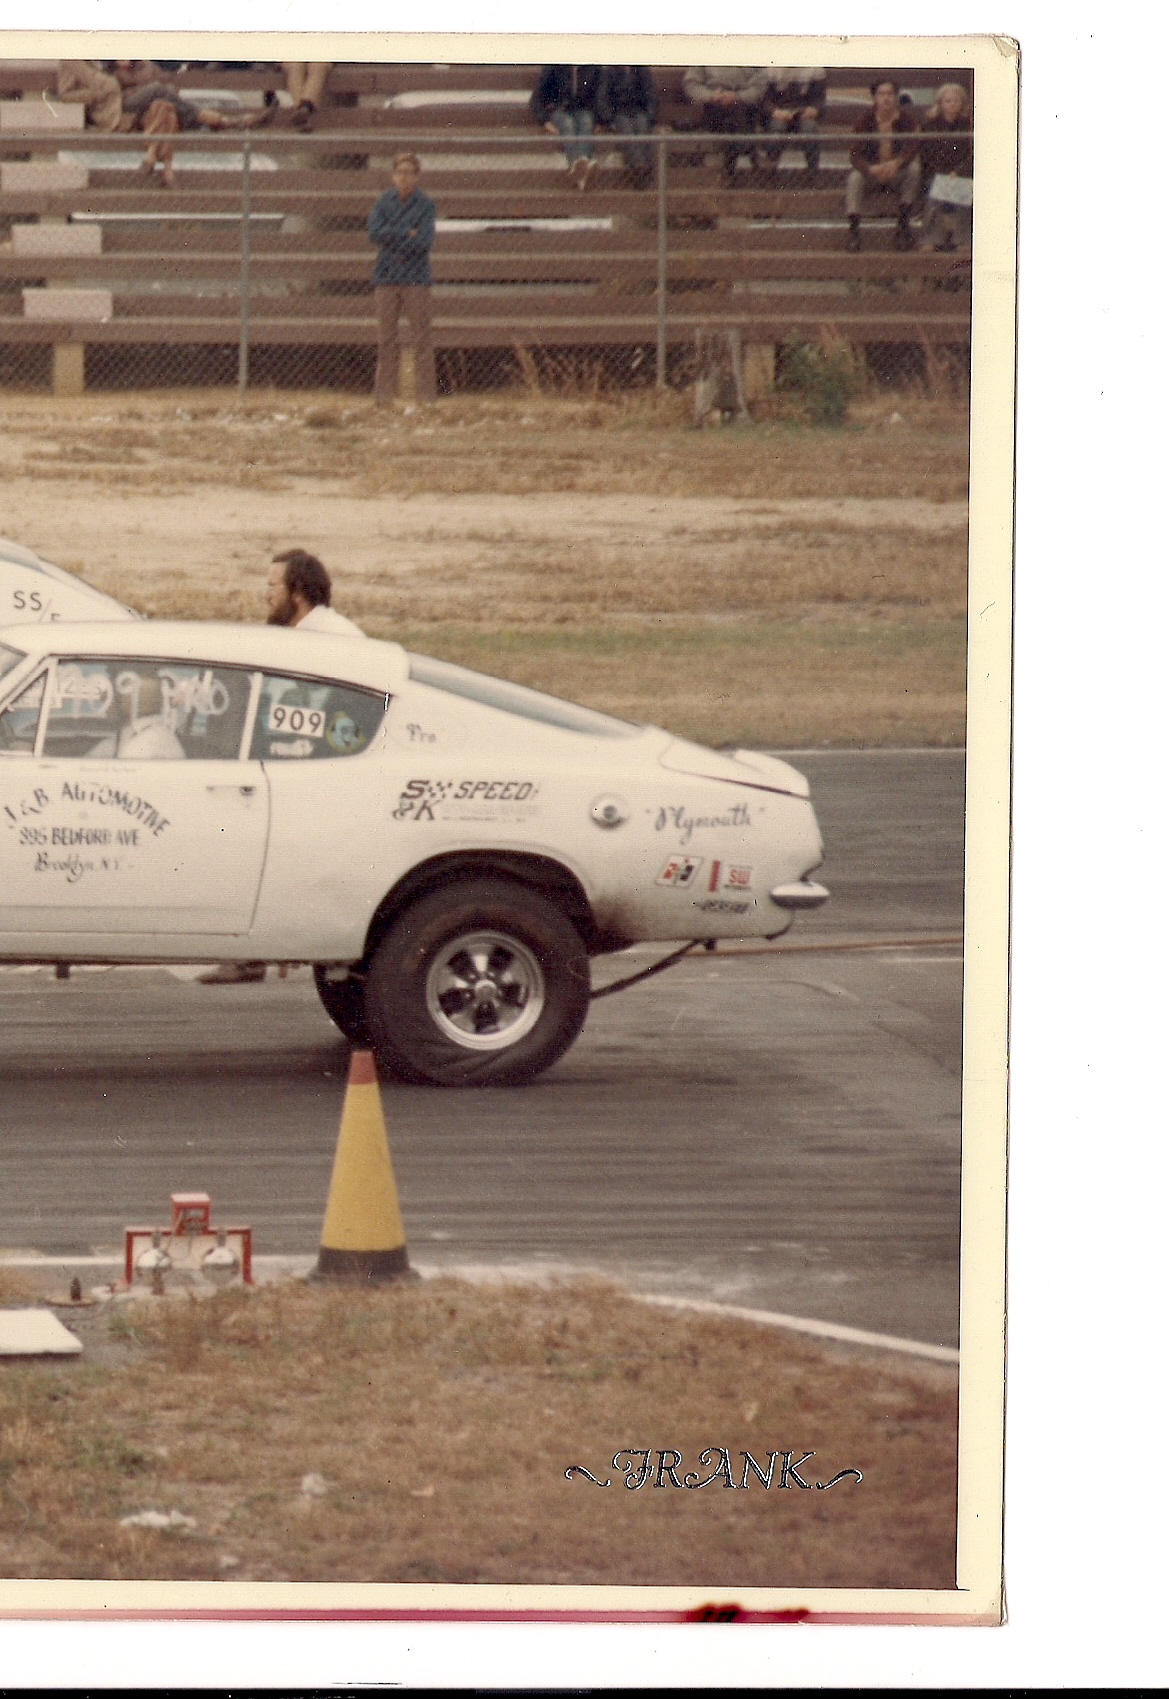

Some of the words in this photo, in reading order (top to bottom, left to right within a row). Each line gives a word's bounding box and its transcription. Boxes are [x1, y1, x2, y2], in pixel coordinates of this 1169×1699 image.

[273, 706, 323, 733] 909
[61, 781, 171, 837] AUTOMOTIVE
[116, 829, 140, 847] AVE
